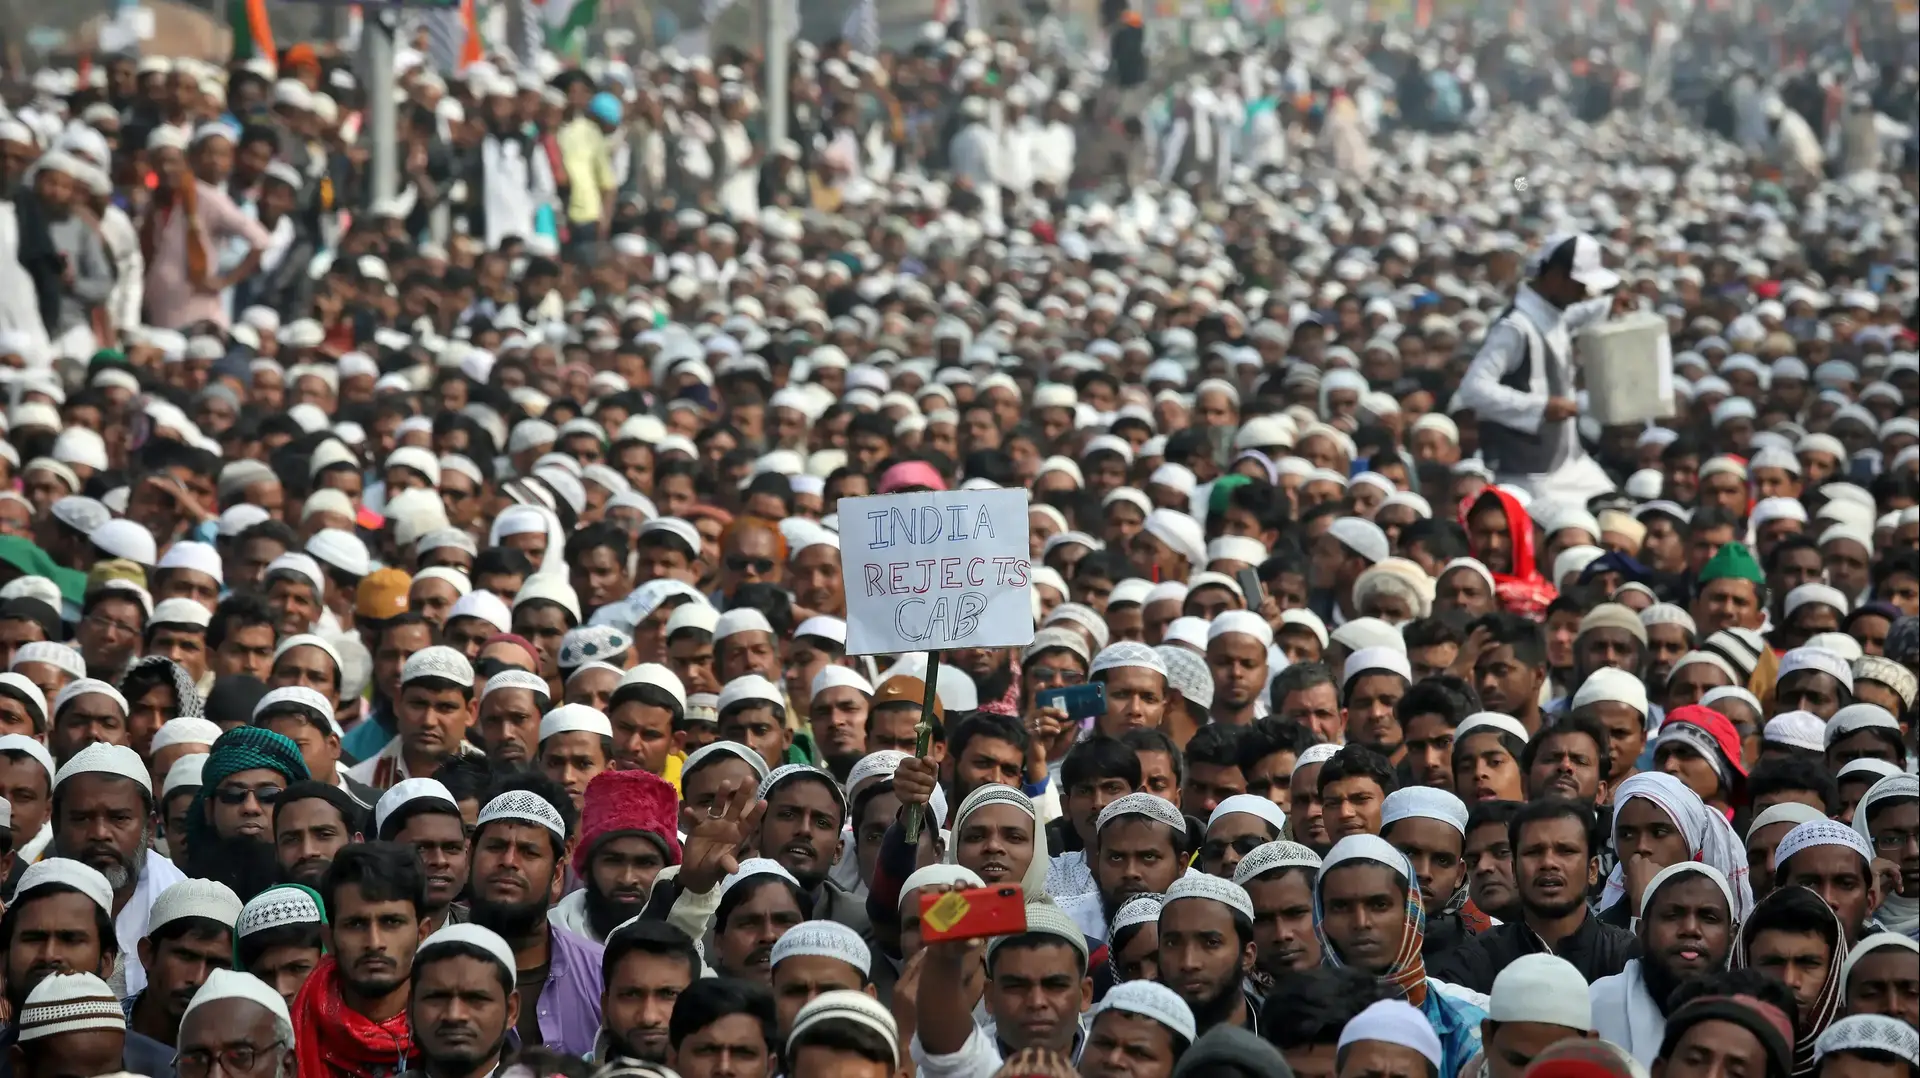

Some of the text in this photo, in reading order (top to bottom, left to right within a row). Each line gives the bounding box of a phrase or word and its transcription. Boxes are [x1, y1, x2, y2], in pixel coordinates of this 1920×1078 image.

[867, 504, 995, 549] INDIA
[864, 557, 1031, 597] REJECTS
[895, 592, 988, 642] CAB
